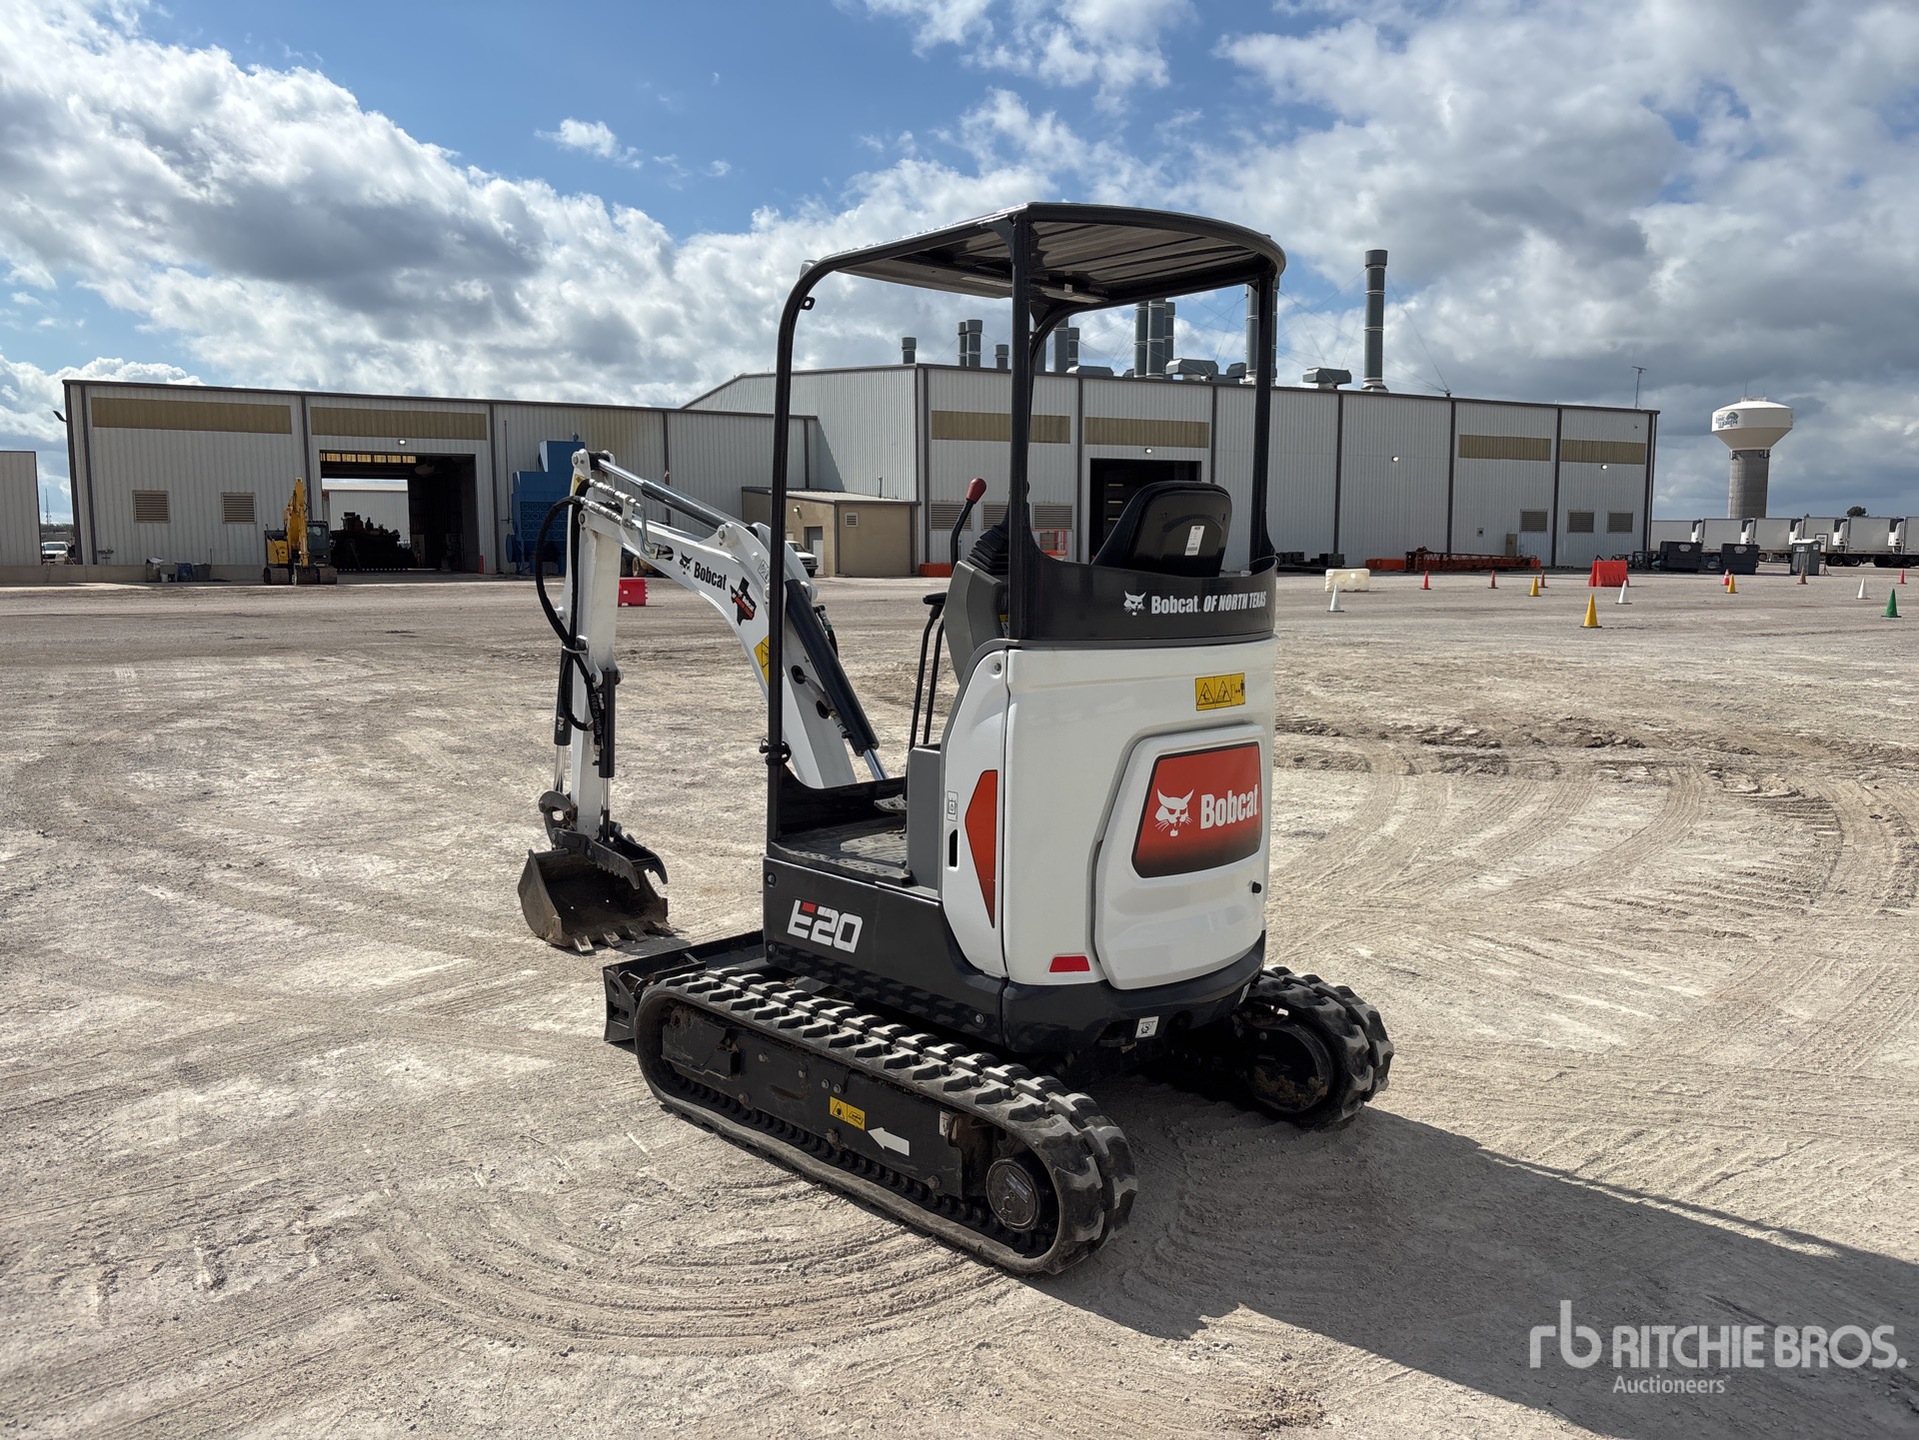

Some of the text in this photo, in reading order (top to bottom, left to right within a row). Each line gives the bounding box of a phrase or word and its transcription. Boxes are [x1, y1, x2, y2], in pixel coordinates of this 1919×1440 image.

[694, 561, 727, 590] Bobcat
[1151, 591, 1266, 614] Bobcat OF NORTH TEXAS
[1200, 783, 1258, 829] Bobcat
[787, 899, 863, 953] E20
